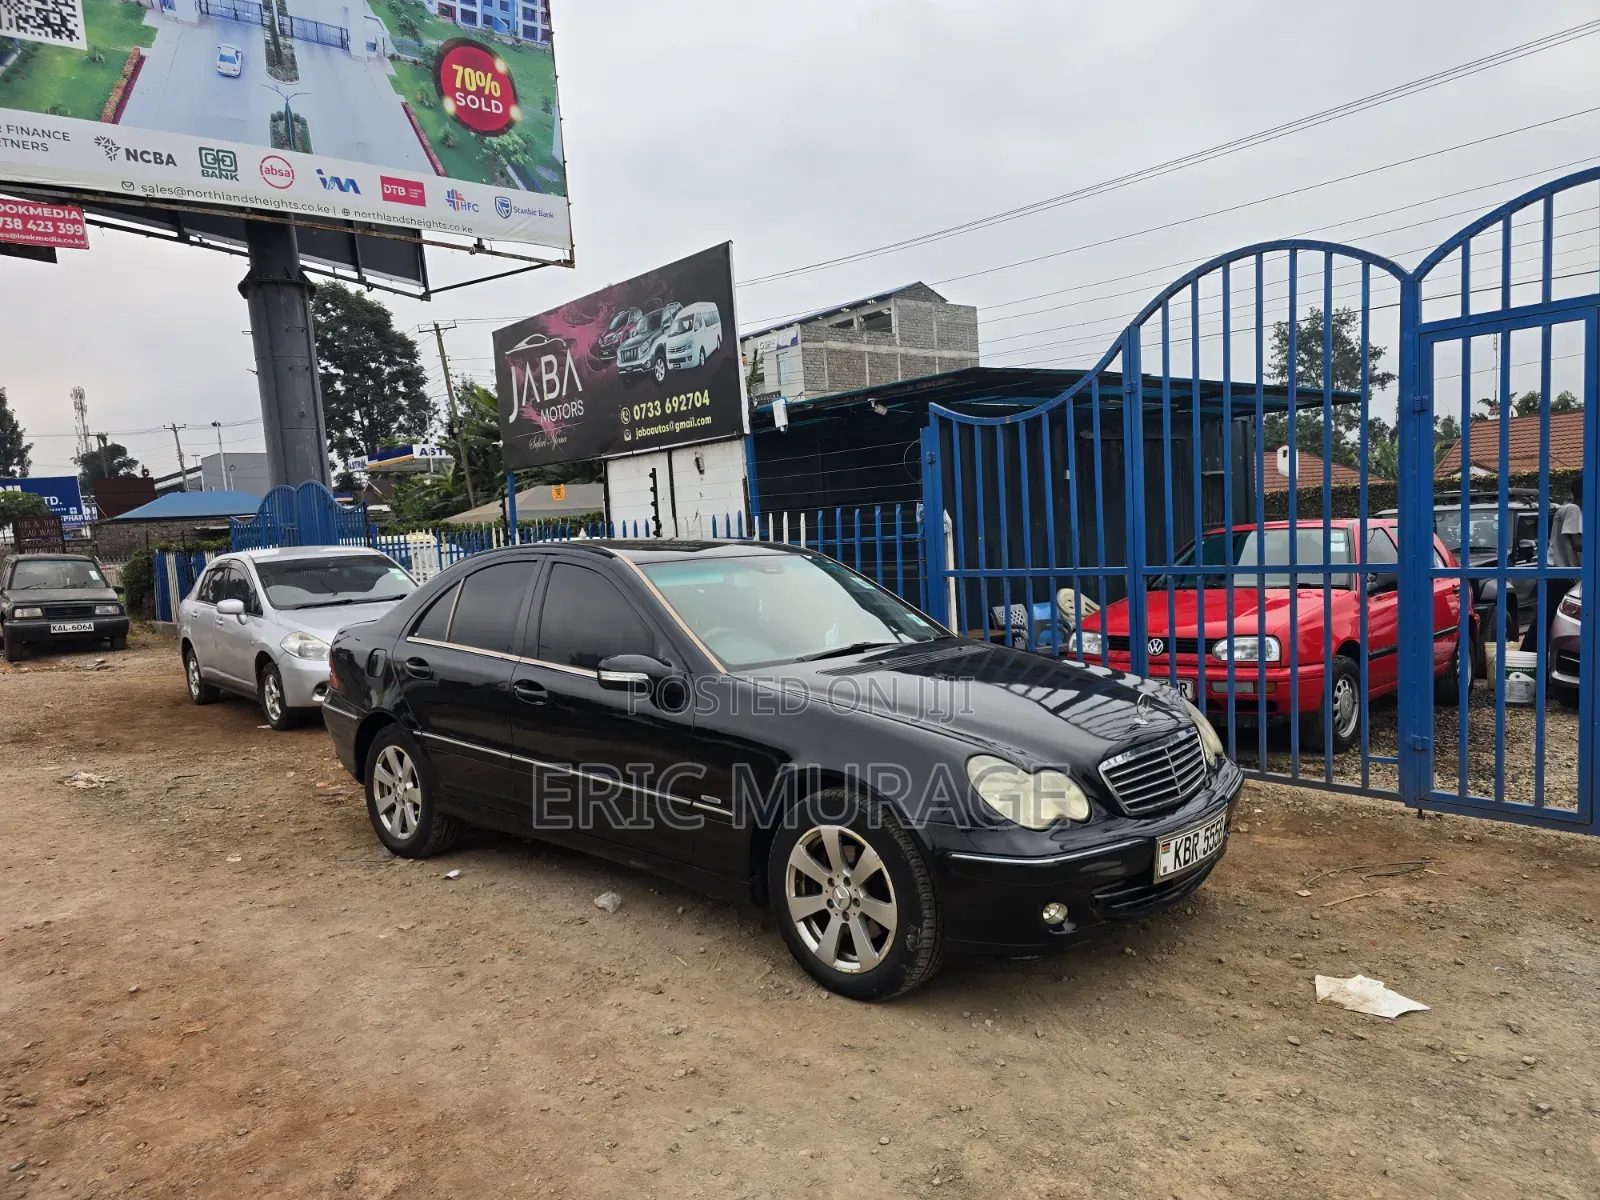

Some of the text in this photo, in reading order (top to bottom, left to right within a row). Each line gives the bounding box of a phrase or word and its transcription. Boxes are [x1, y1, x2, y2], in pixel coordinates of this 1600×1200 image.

[452, 64, 500, 98] 70%
[455, 92, 503, 114] SOLD
[7, 124, 71, 142] FINANCE
[0, 137, 49, 152] TNERS
[125, 148, 177, 167] NCBA
[201, 169, 240, 182] BANK
[264, 165, 291, 178] absa
[383, 184, 407, 197] DTB
[141, 183, 473, 234] sales@northlandsheights.co.ke northlandsheights.co.ke
[461, 201, 479, 213] HFC
[513, 207, 554, 219] Stanbic Bank
[27, 220, 54, 233] 423
[57, 222, 83, 236] 399
[509, 348, 583, 424] JABA
[540, 400, 584, 424] MOTORS
[633, 389, 710, 421] 0733 692704
[1173, 832, 1200, 870] KBR
